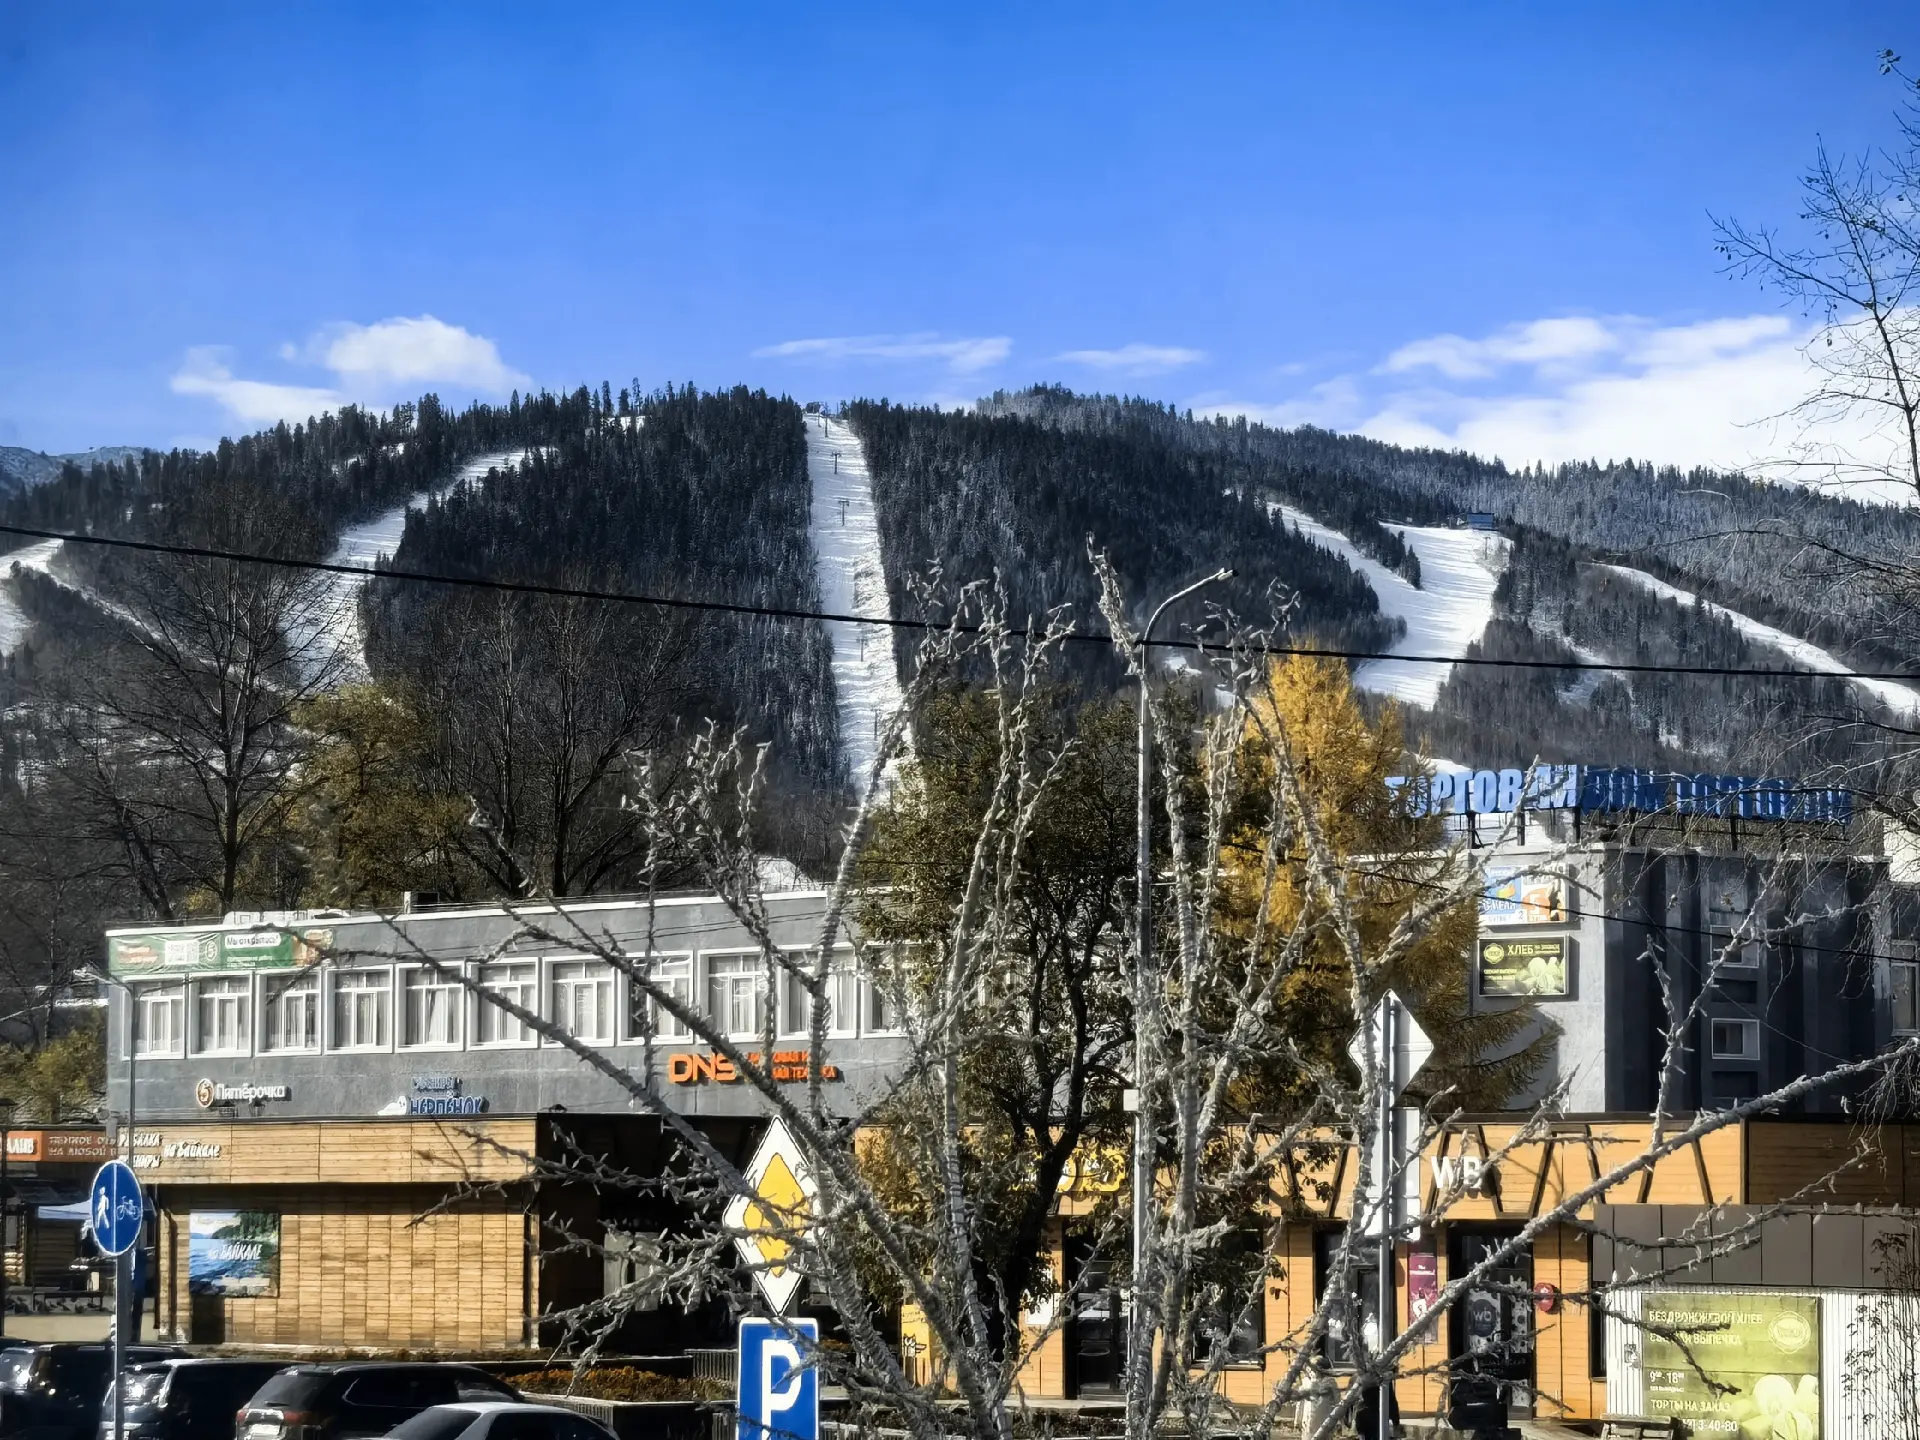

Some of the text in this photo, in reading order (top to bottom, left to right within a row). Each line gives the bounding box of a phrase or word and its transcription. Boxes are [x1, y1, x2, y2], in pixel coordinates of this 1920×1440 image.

[1507, 944, 1534, 955] ХЛЕБ
[669, 1054, 737, 1083] DNS
[216, 1082, 285, 1104] Пятёрочка
[1431, 1155, 1483, 1190] WB
[1649, 1310, 1763, 1324] БЕЗДРОЖЖЕВОЙ ХЛЕБ
[1693, 1333, 1743, 1346] ВЫПЕЧКА
[761, 1339, 802, 1440] P
[1651, 1399, 1732, 1413] ТОРТЫ НА ЗАКАЗ
[1698, 1420, 1738, 1433] 3-40-80
